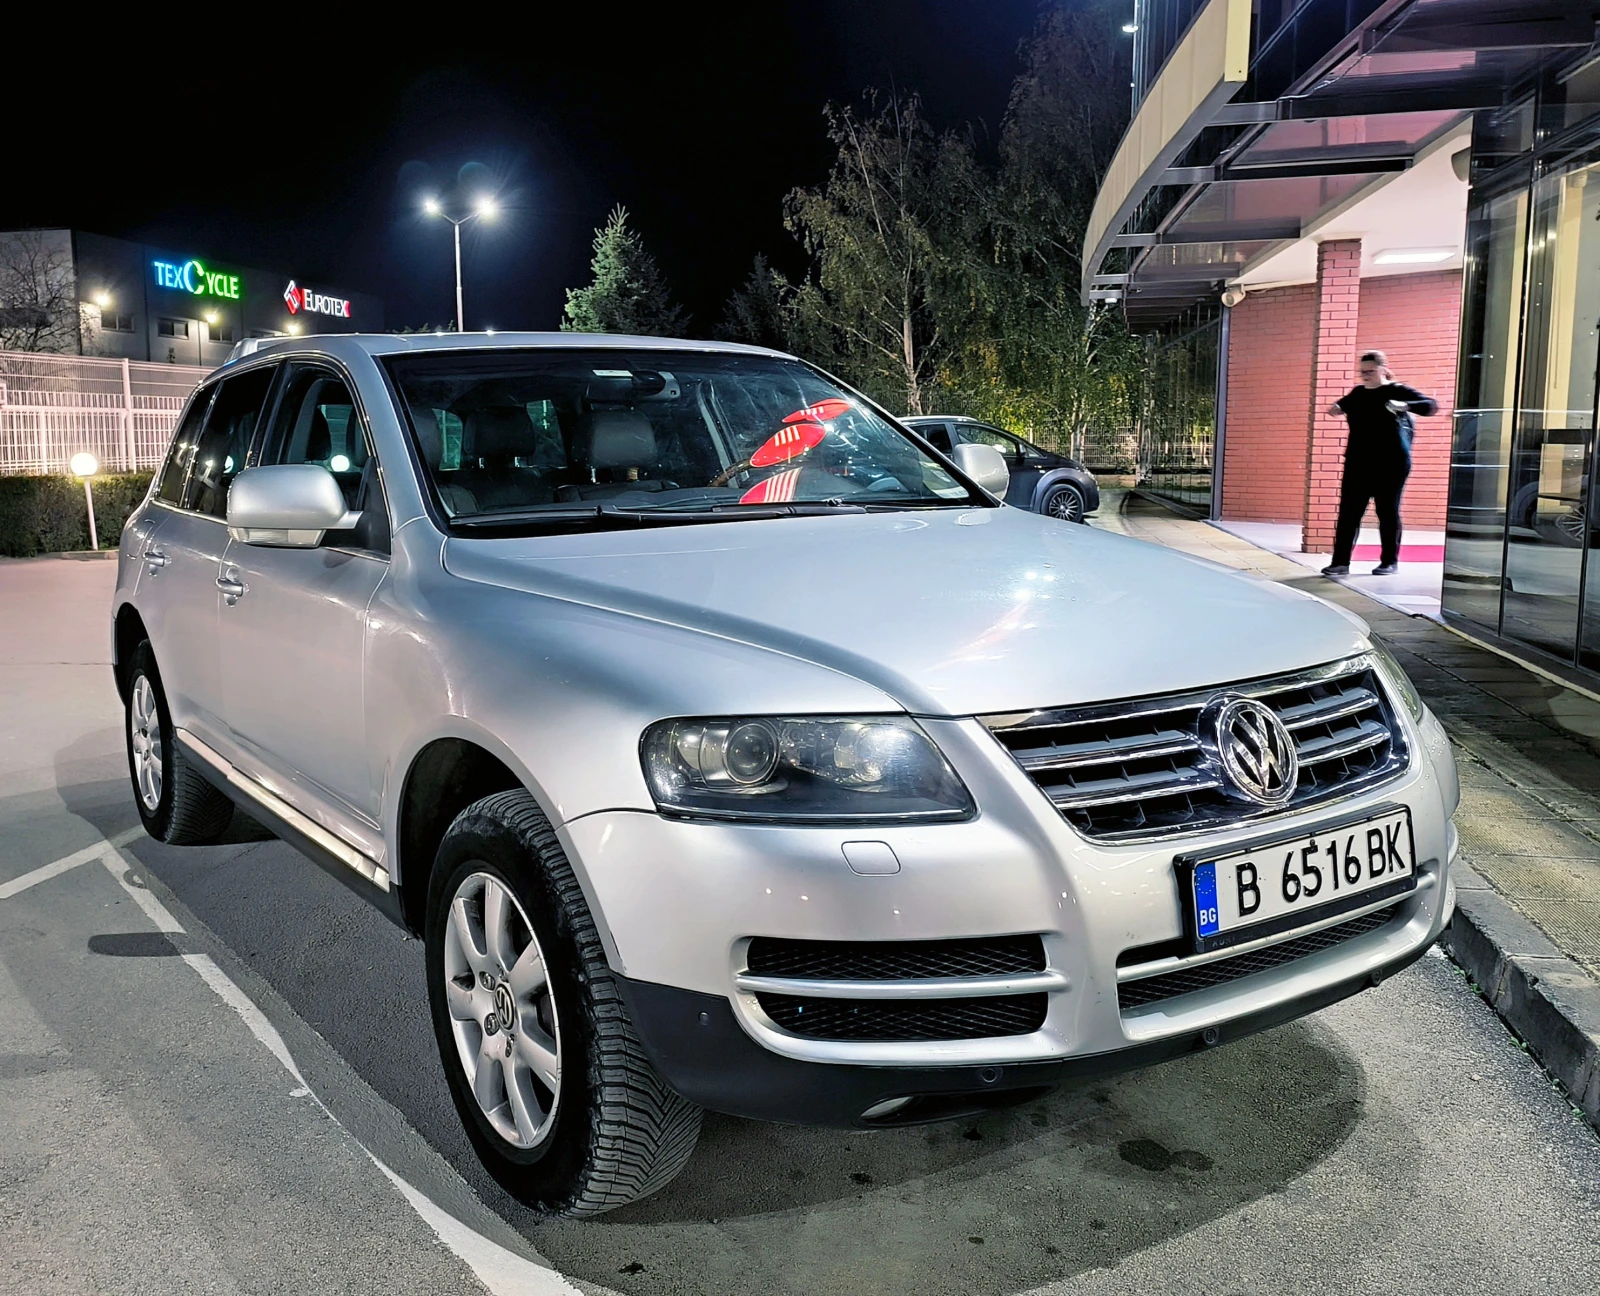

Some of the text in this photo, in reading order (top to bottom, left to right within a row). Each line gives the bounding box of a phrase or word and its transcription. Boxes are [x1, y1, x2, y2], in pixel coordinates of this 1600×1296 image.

[303, 288, 350, 317] EUROTEX
[1235, 820, 1405, 917] B 6516 BK
[1200, 907, 1217, 926] BG
